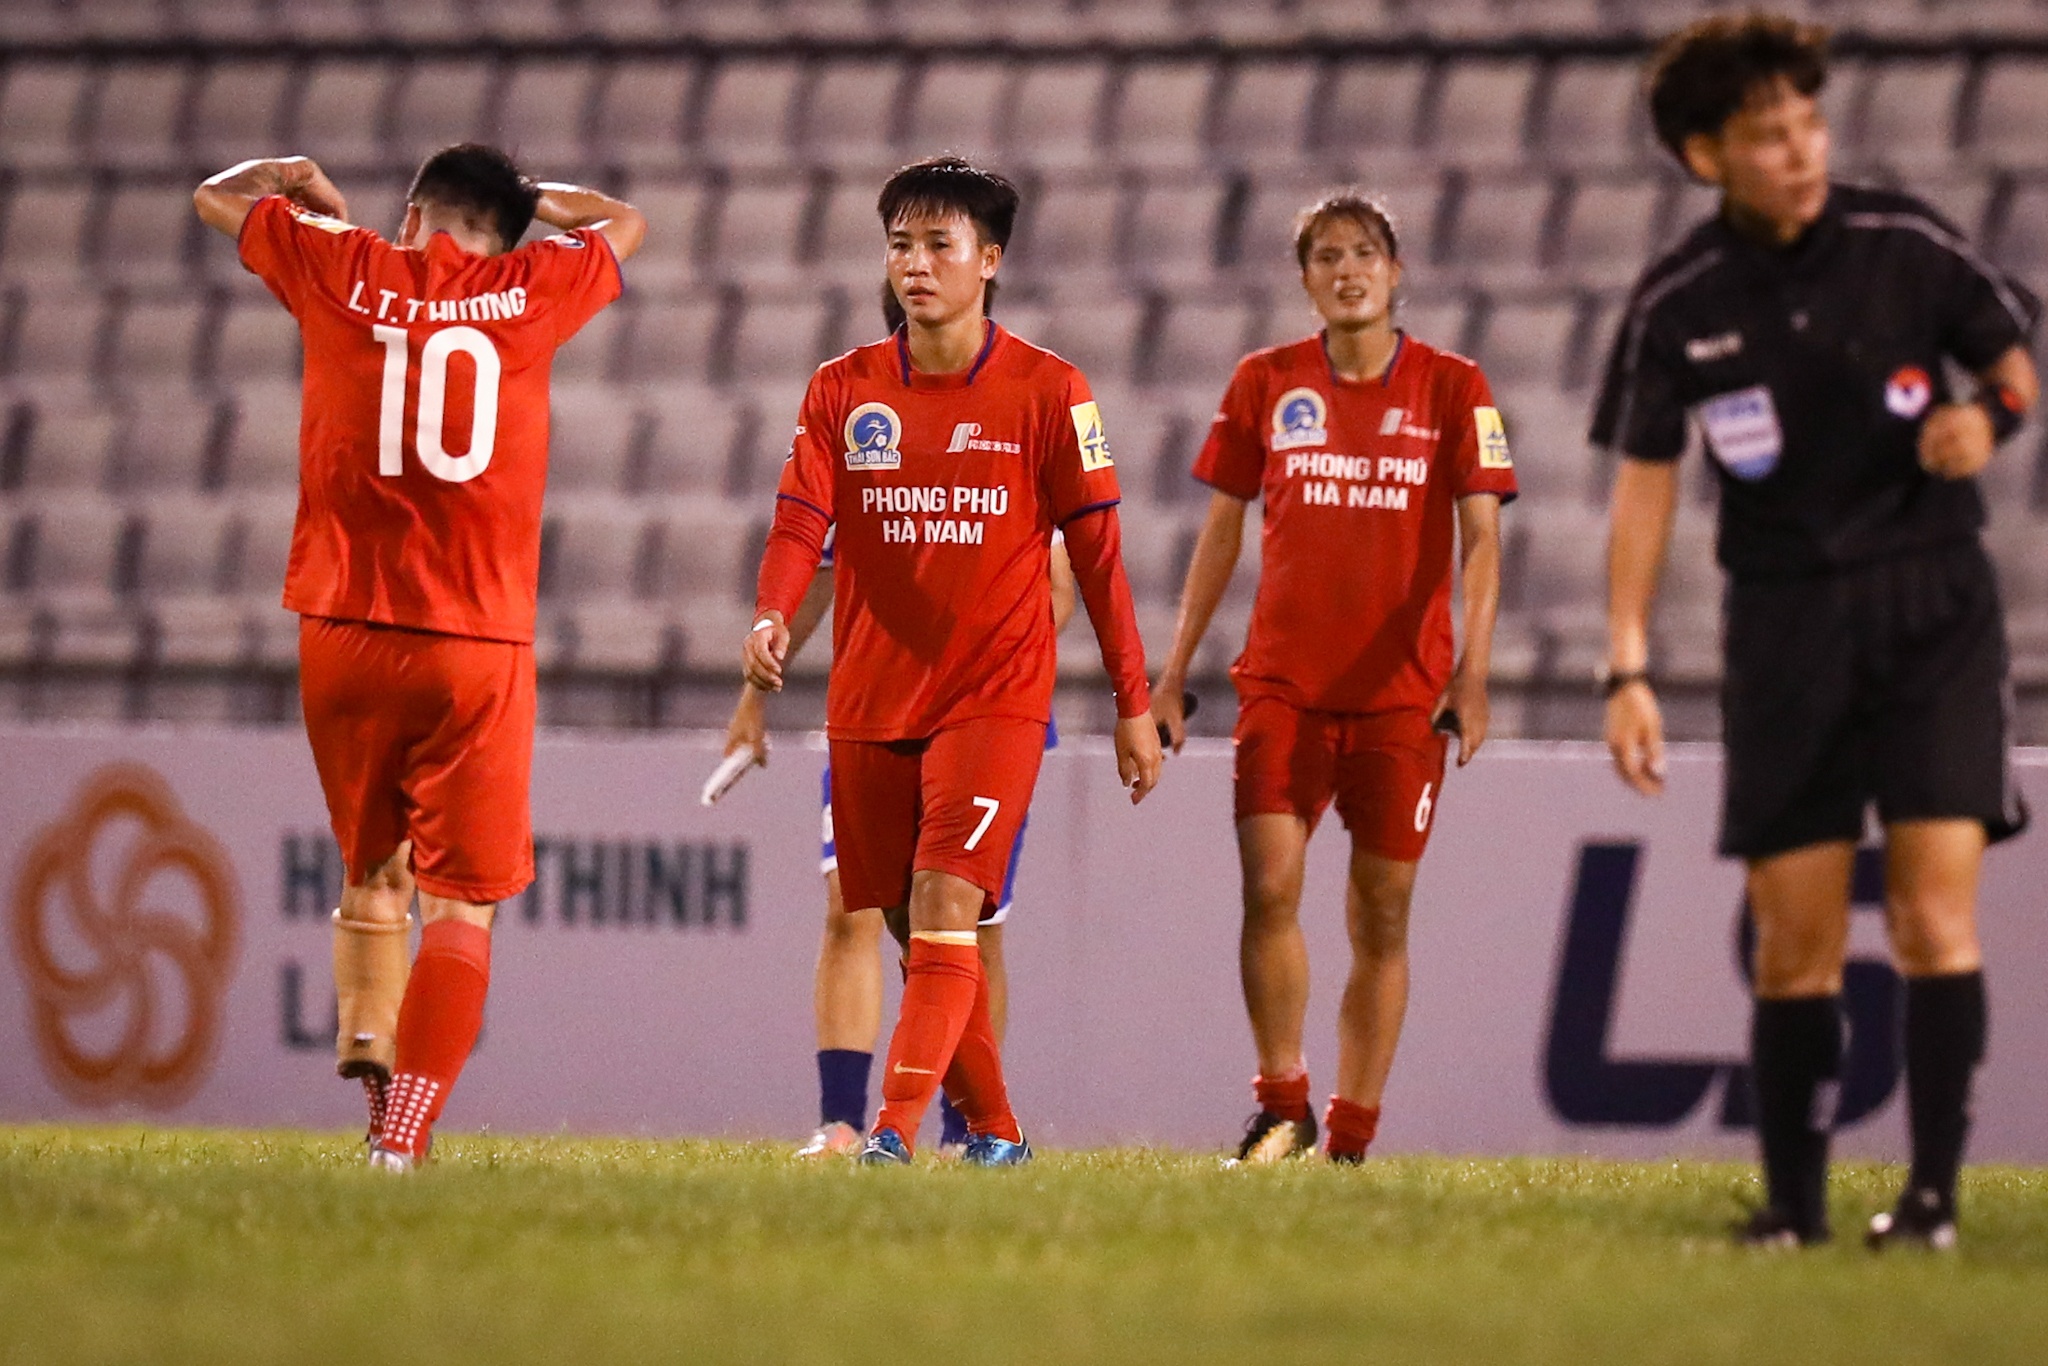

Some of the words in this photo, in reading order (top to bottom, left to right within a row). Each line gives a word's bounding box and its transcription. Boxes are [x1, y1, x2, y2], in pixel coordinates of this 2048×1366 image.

[372, 324, 501, 482] 10
[1285, 452, 1371, 481] PHONG
[1377, 455, 1428, 486] PHÚ
[862, 486, 947, 513] PHONG
[953, 485, 1008, 516] PHÚ
[1303, 479, 1341, 506] HÀ
[1348, 485, 1409, 511] NAM
[882, 516, 917, 543] HÀ
[924, 520, 984, 545] NAM
[963, 795, 1000, 851] 7
[1414, 782, 1432, 833] 6
